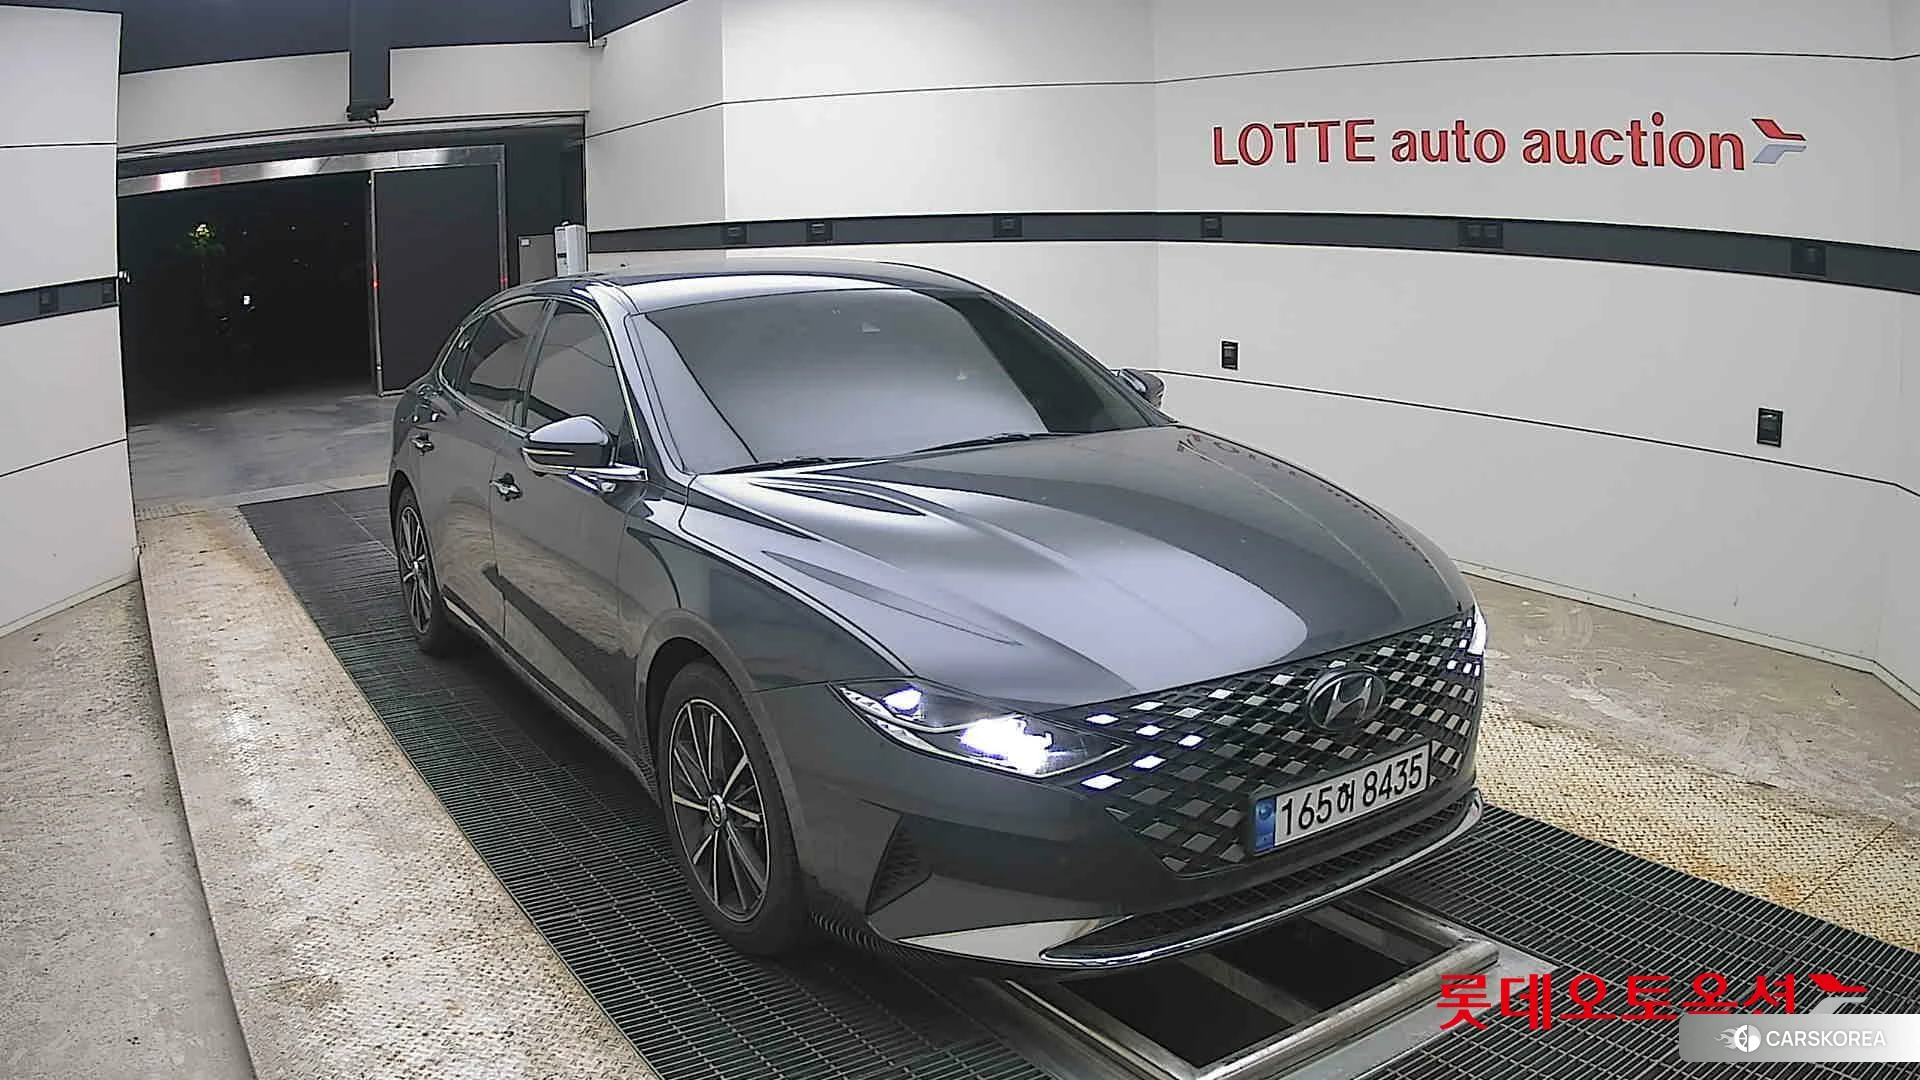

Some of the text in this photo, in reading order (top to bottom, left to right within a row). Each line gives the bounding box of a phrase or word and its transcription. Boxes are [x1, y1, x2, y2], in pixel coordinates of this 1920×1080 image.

[1212, 111, 1746, 171] LOTTE auto auction
[1281, 752, 1423, 836] 165허 8435
